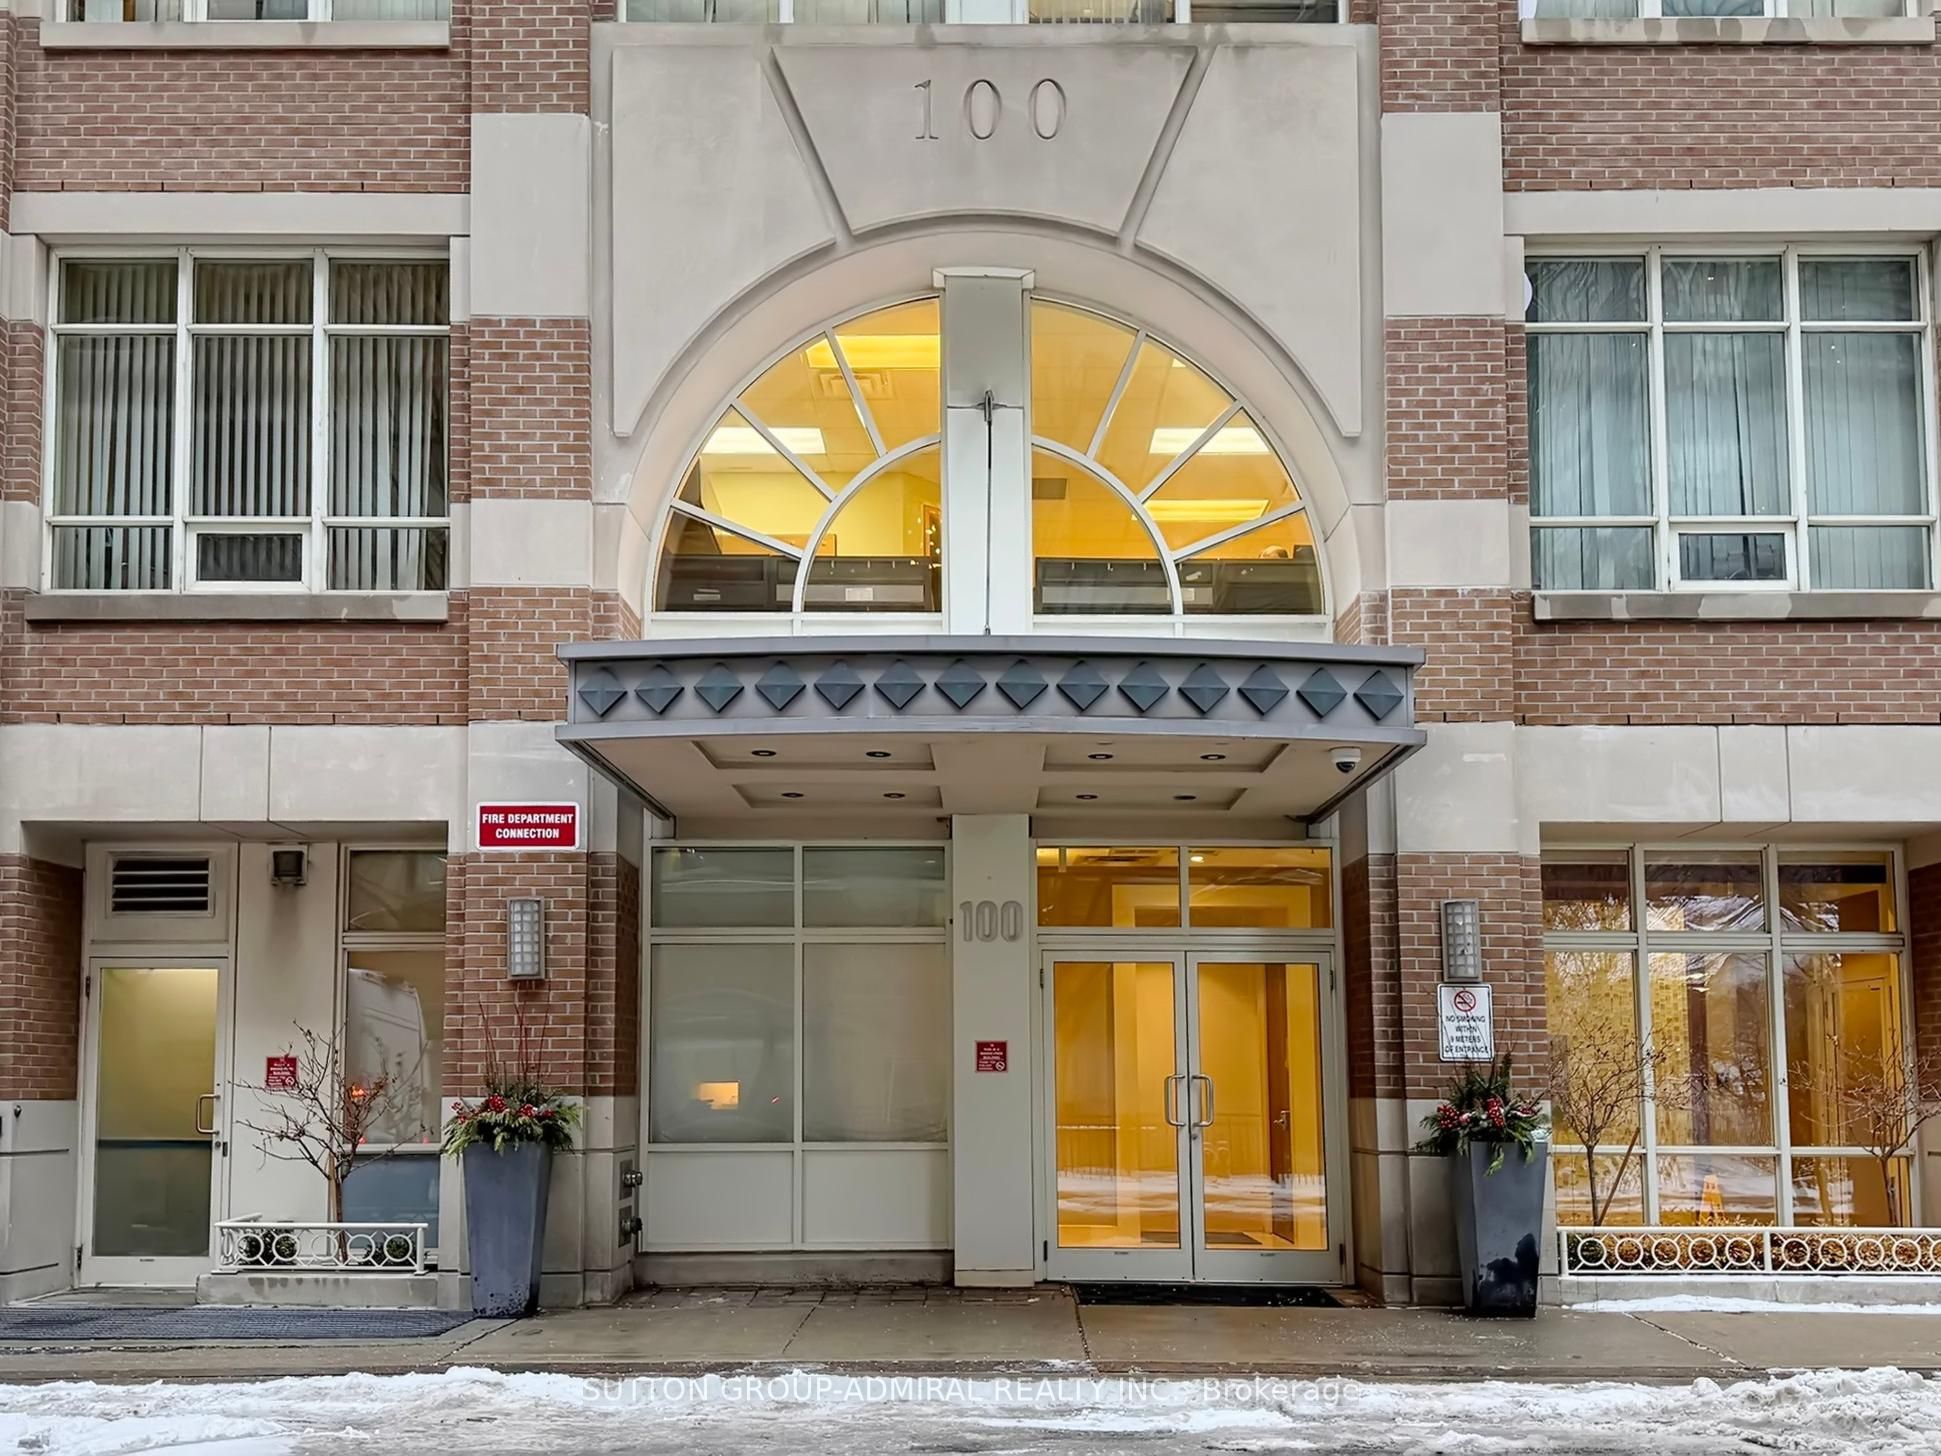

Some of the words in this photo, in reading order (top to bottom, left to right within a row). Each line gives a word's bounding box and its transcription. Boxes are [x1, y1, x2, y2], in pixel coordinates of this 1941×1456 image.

[914, 78, 1067, 140] 100
[482, 813, 505, 824] FIRE
[507, 813, 574, 824] DEPARTMENT
[495, 828, 560, 839] CONNECTION
[959, 900, 1023, 943] 100
[1445, 1014, 1456, 1023] NO
[1455, 1035, 1482, 1043] METERS
[1445, 1046, 1454, 1054] OF
[1455, 1046, 1489, 1054] ENTRANCE
